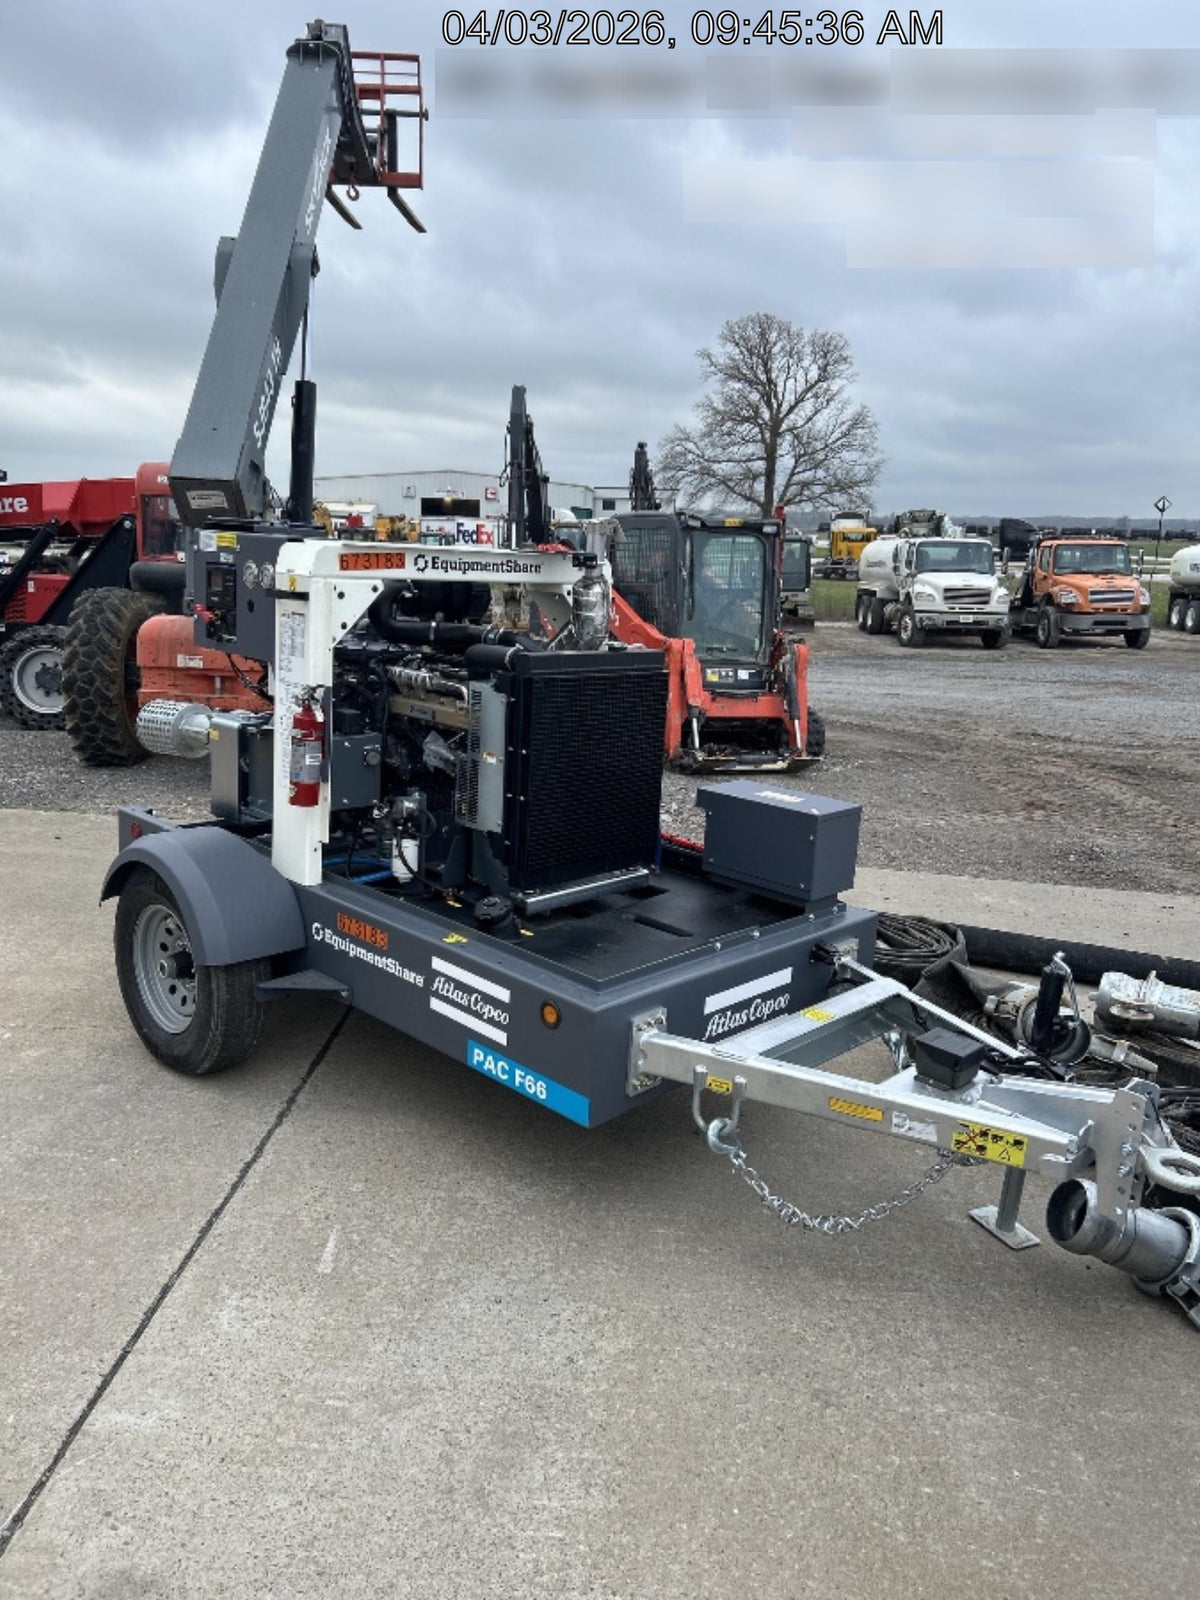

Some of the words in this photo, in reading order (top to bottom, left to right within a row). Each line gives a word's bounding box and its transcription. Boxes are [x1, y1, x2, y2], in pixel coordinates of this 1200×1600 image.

[456, 522, 494, 545] FedEx
[340, 553, 404, 571] 673183
[431, 556, 542, 575] EquipmentShare
[324, 928, 425, 988] EquipmentShare
[431, 975, 469, 1006] Atlas
[470, 992, 510, 1025] Copco
[702, 1008, 749, 1041] Atlas
[749, 993, 791, 1021] Copco
[473, 1048, 510, 1080] PAC
[514, 1068, 548, 1100] F66
